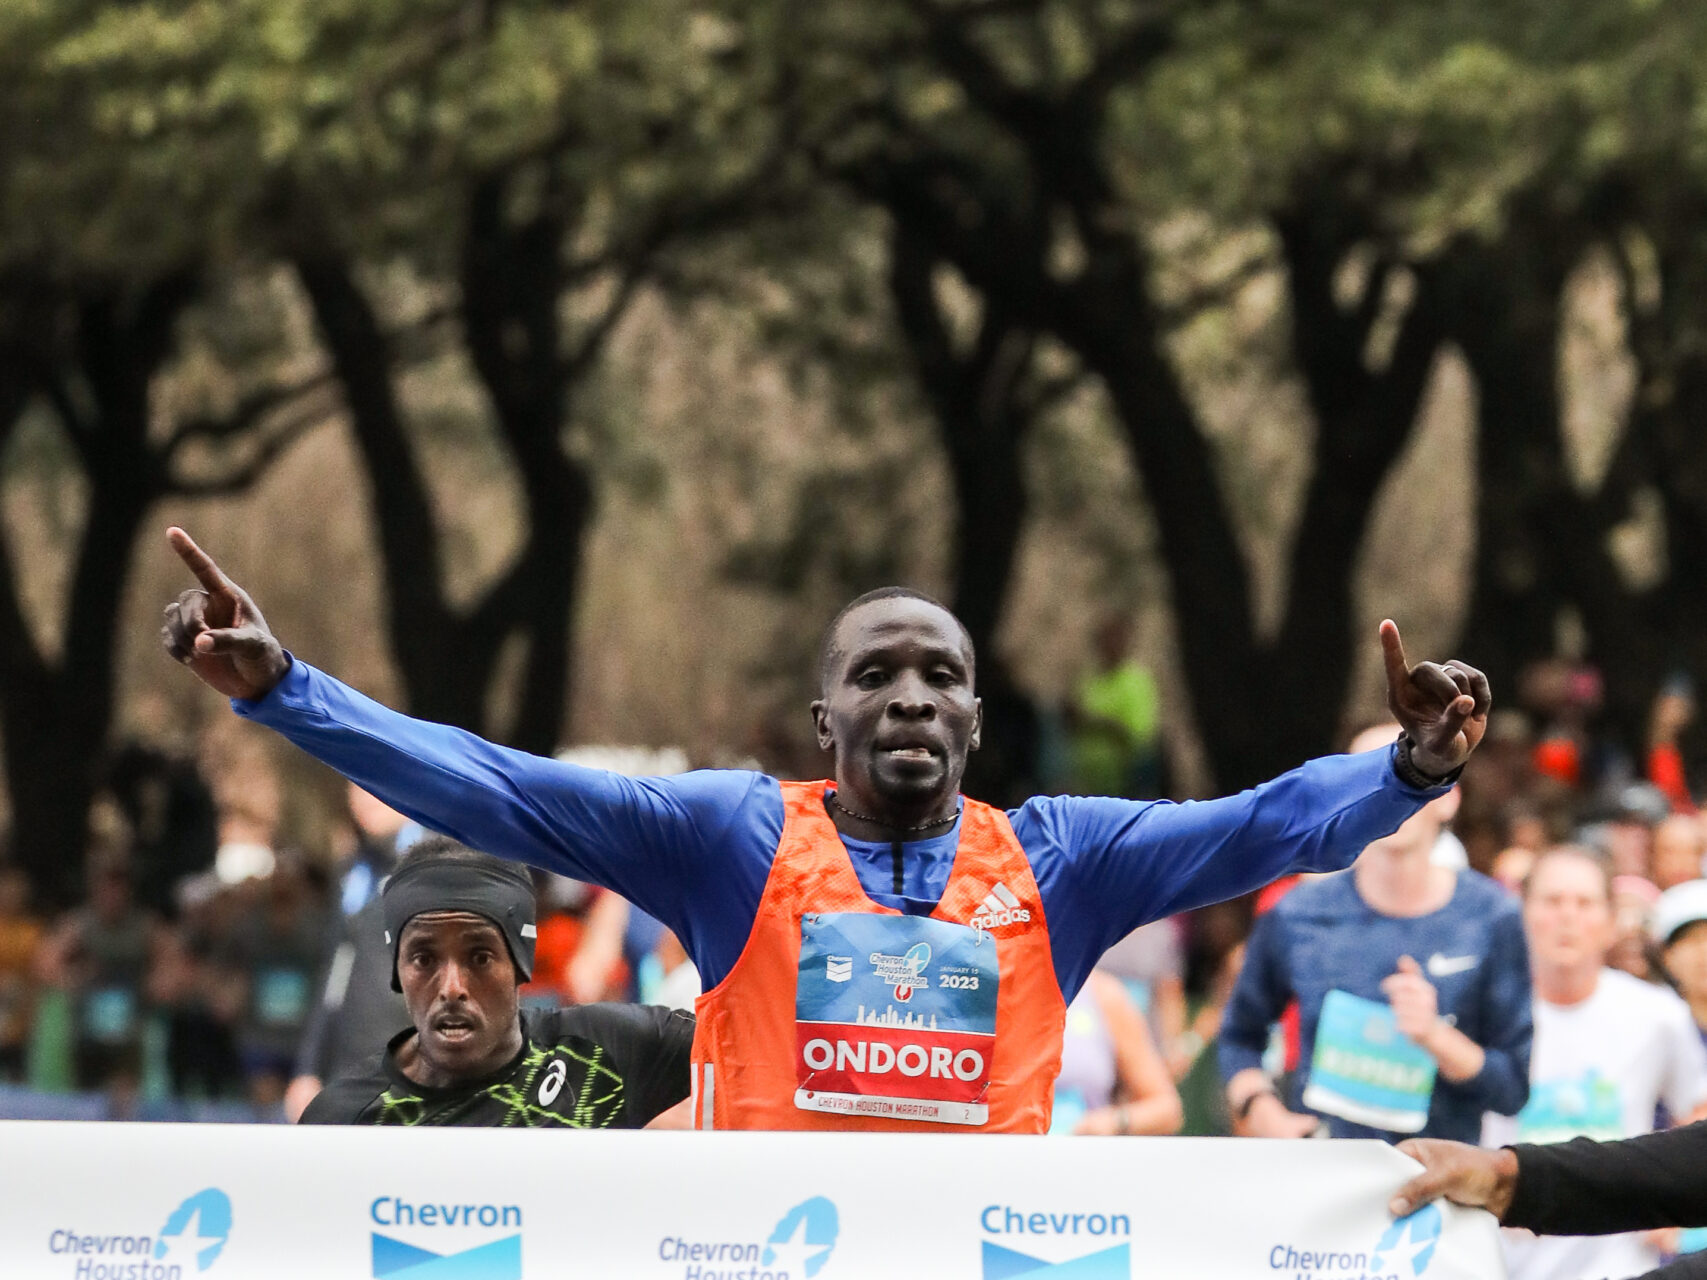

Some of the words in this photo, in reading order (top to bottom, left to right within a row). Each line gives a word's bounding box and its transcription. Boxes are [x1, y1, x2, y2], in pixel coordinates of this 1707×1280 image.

[970, 908, 1031, 930] adidas
[870, 953, 904, 965] Chevron
[878, 965, 912, 975] Houston
[940, 966, 969, 974] JANUARY
[887, 974, 928, 985] Marathon
[939, 974, 980, 990] 2023
[803, 1038, 984, 1082] ONDORO
[818, 1096, 853, 1111] CHEVRON
[856, 1101, 893, 1114] HOUSTON
[896, 1105, 939, 1117] MARATHON
[964, 1109, 970, 1120] 2
[371, 1196, 522, 1227] Chevron
[980, 1204, 1131, 1236] Chevron
[49, 1229, 152, 1255] Chevron
[659, 1236, 760, 1262] Chevron
[1269, 1244, 1367, 1271] Chevron
